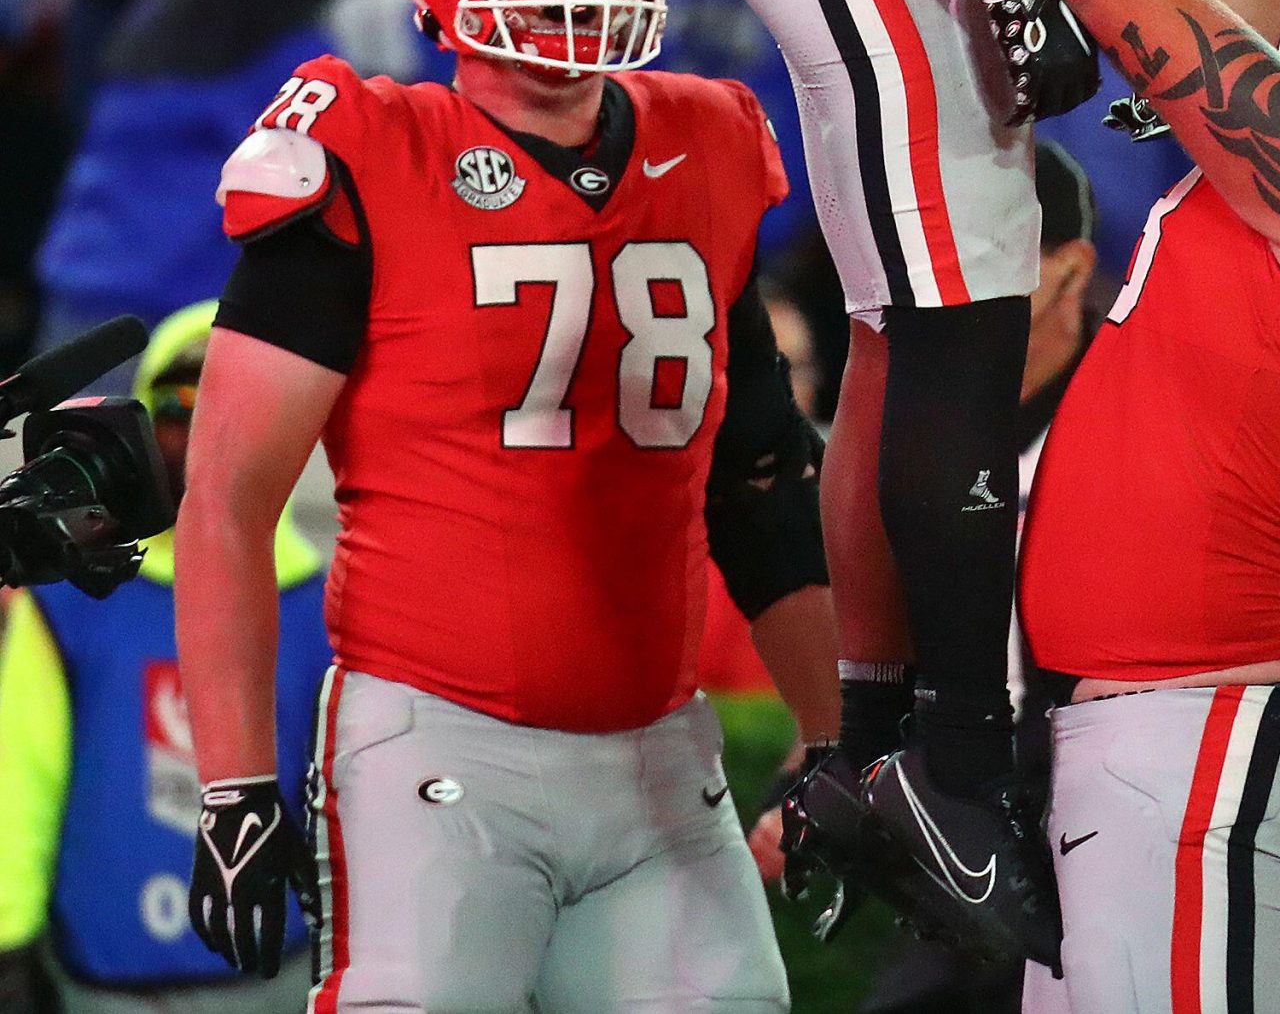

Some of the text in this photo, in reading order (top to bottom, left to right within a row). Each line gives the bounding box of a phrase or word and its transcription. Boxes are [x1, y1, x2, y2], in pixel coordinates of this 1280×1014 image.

[255, 76, 338, 134] 78
[459, 149, 510, 194] SEC
[470, 241, 716, 450] 78
